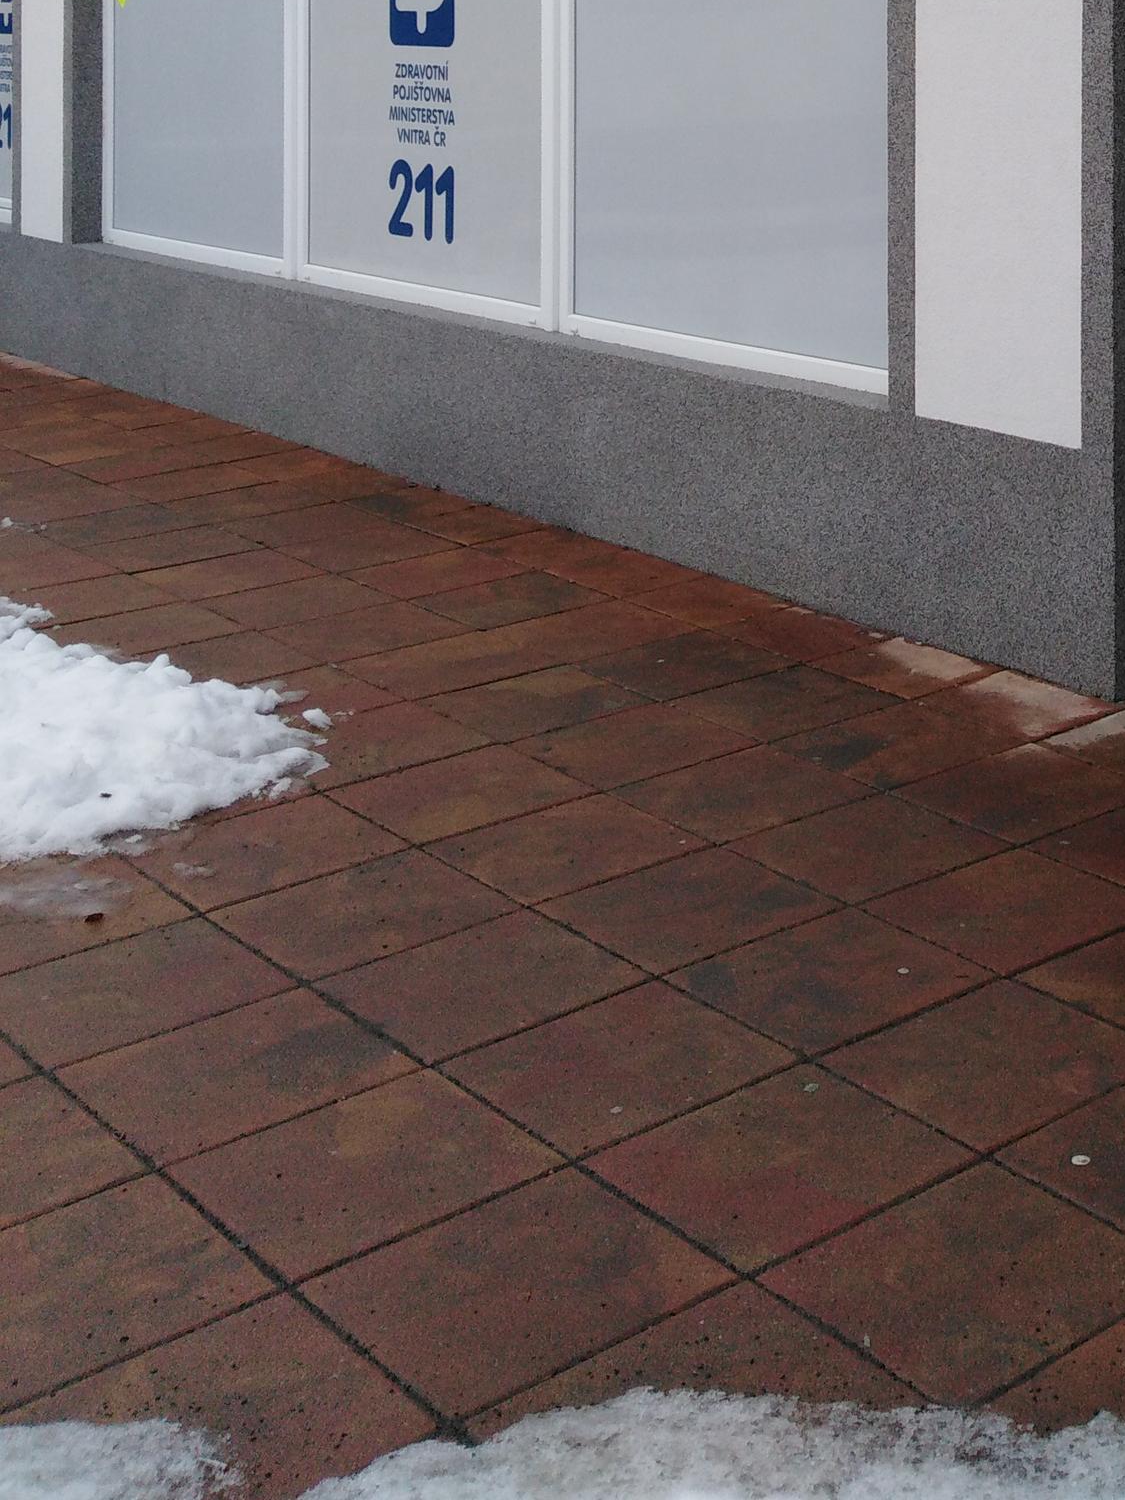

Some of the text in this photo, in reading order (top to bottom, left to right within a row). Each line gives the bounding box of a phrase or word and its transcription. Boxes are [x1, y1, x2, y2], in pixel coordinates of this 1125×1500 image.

[395, 61, 449, 81] ZDRAVOTNÍ
[393, 81, 452, 103] POJIŠŤOVNA
[389, 105, 455, 126] MINISTERSTVA
[397, 126, 446, 147] VNITRA ČR
[389, 159, 454, 244] 211
